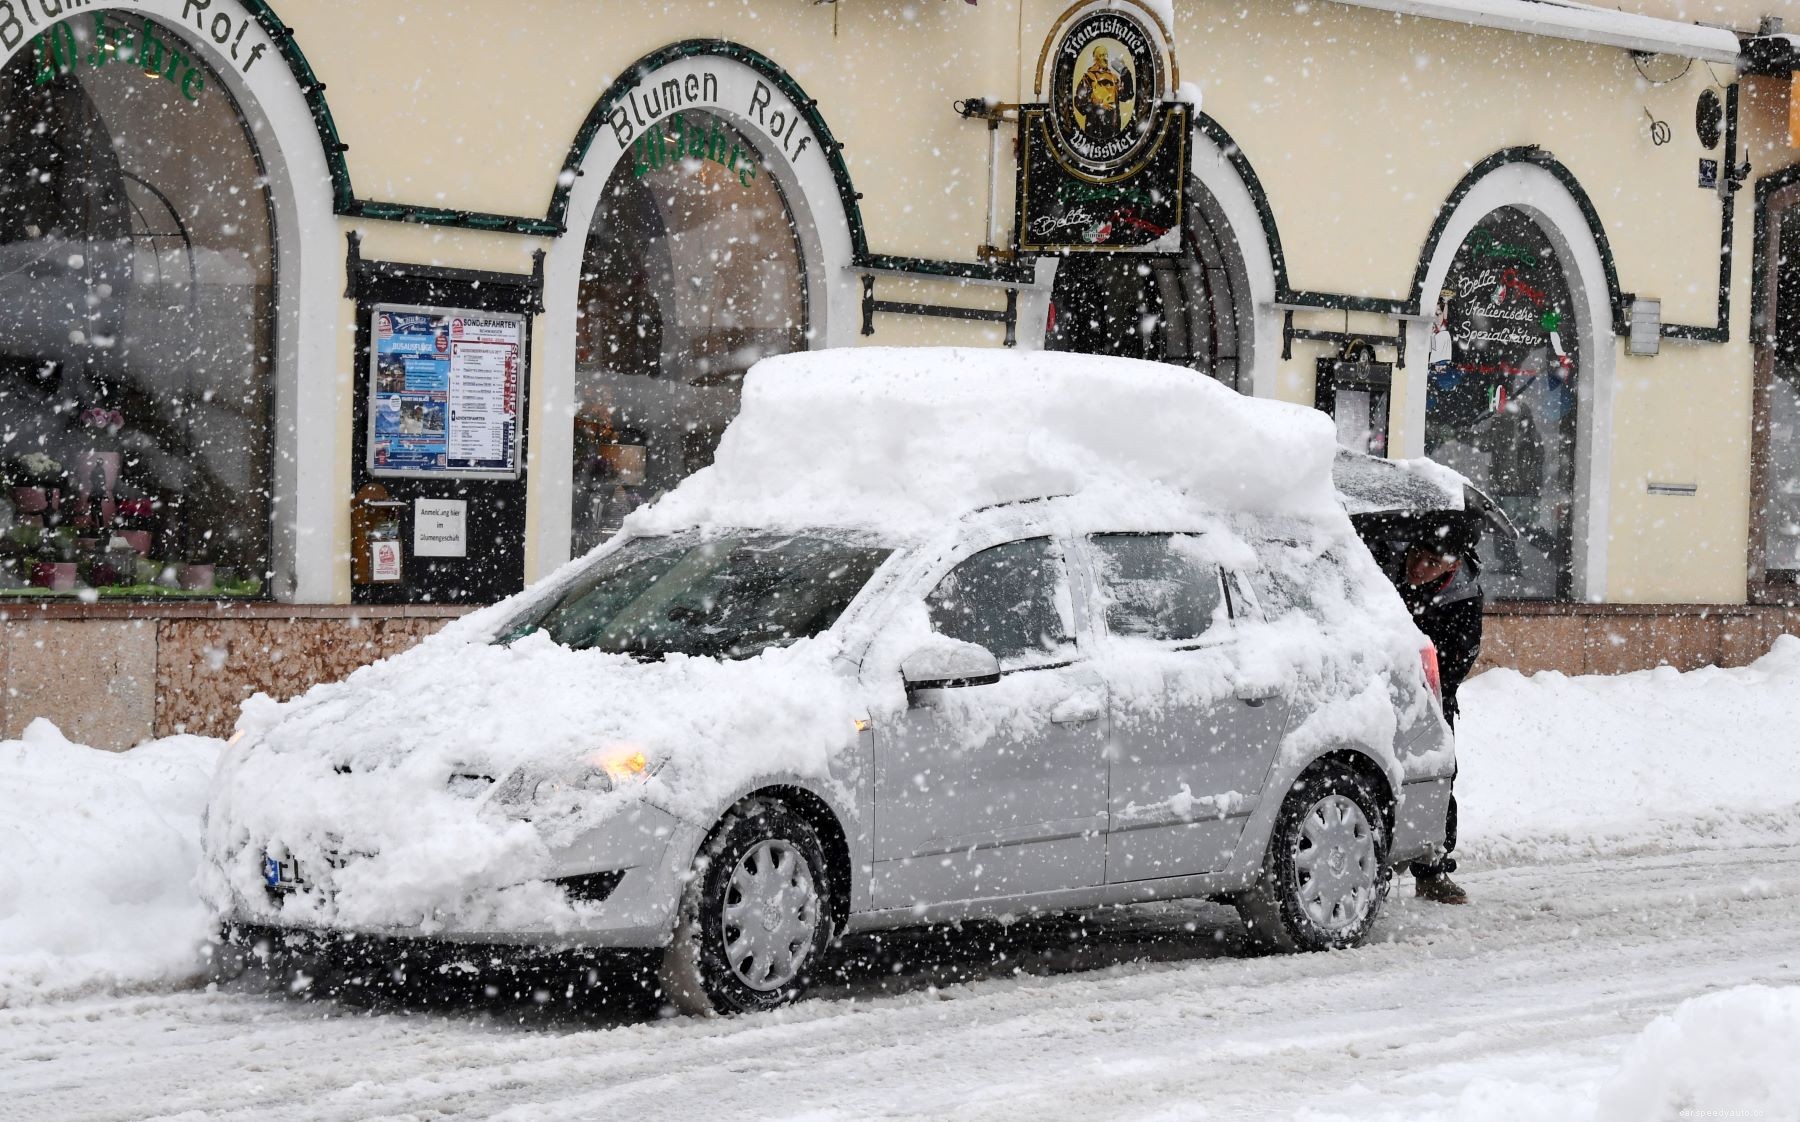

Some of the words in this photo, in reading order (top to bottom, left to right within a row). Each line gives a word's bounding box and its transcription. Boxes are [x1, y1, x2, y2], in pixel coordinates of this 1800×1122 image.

[182, 0, 268, 73] Rolf
[88, 9, 205, 101] Jahre
[608, 72, 719, 150] Blumen
[748, 80, 811, 163] Rolf
[671, 113, 757, 188] Jahre
[1034, 207, 1093, 236] Bella
[1458, 270, 1497, 298] Bella
[1465, 295, 1534, 322] Italienische
[463, 318, 517, 329] SONDERFAHRTEN
[450, 508, 460, 517] hier
